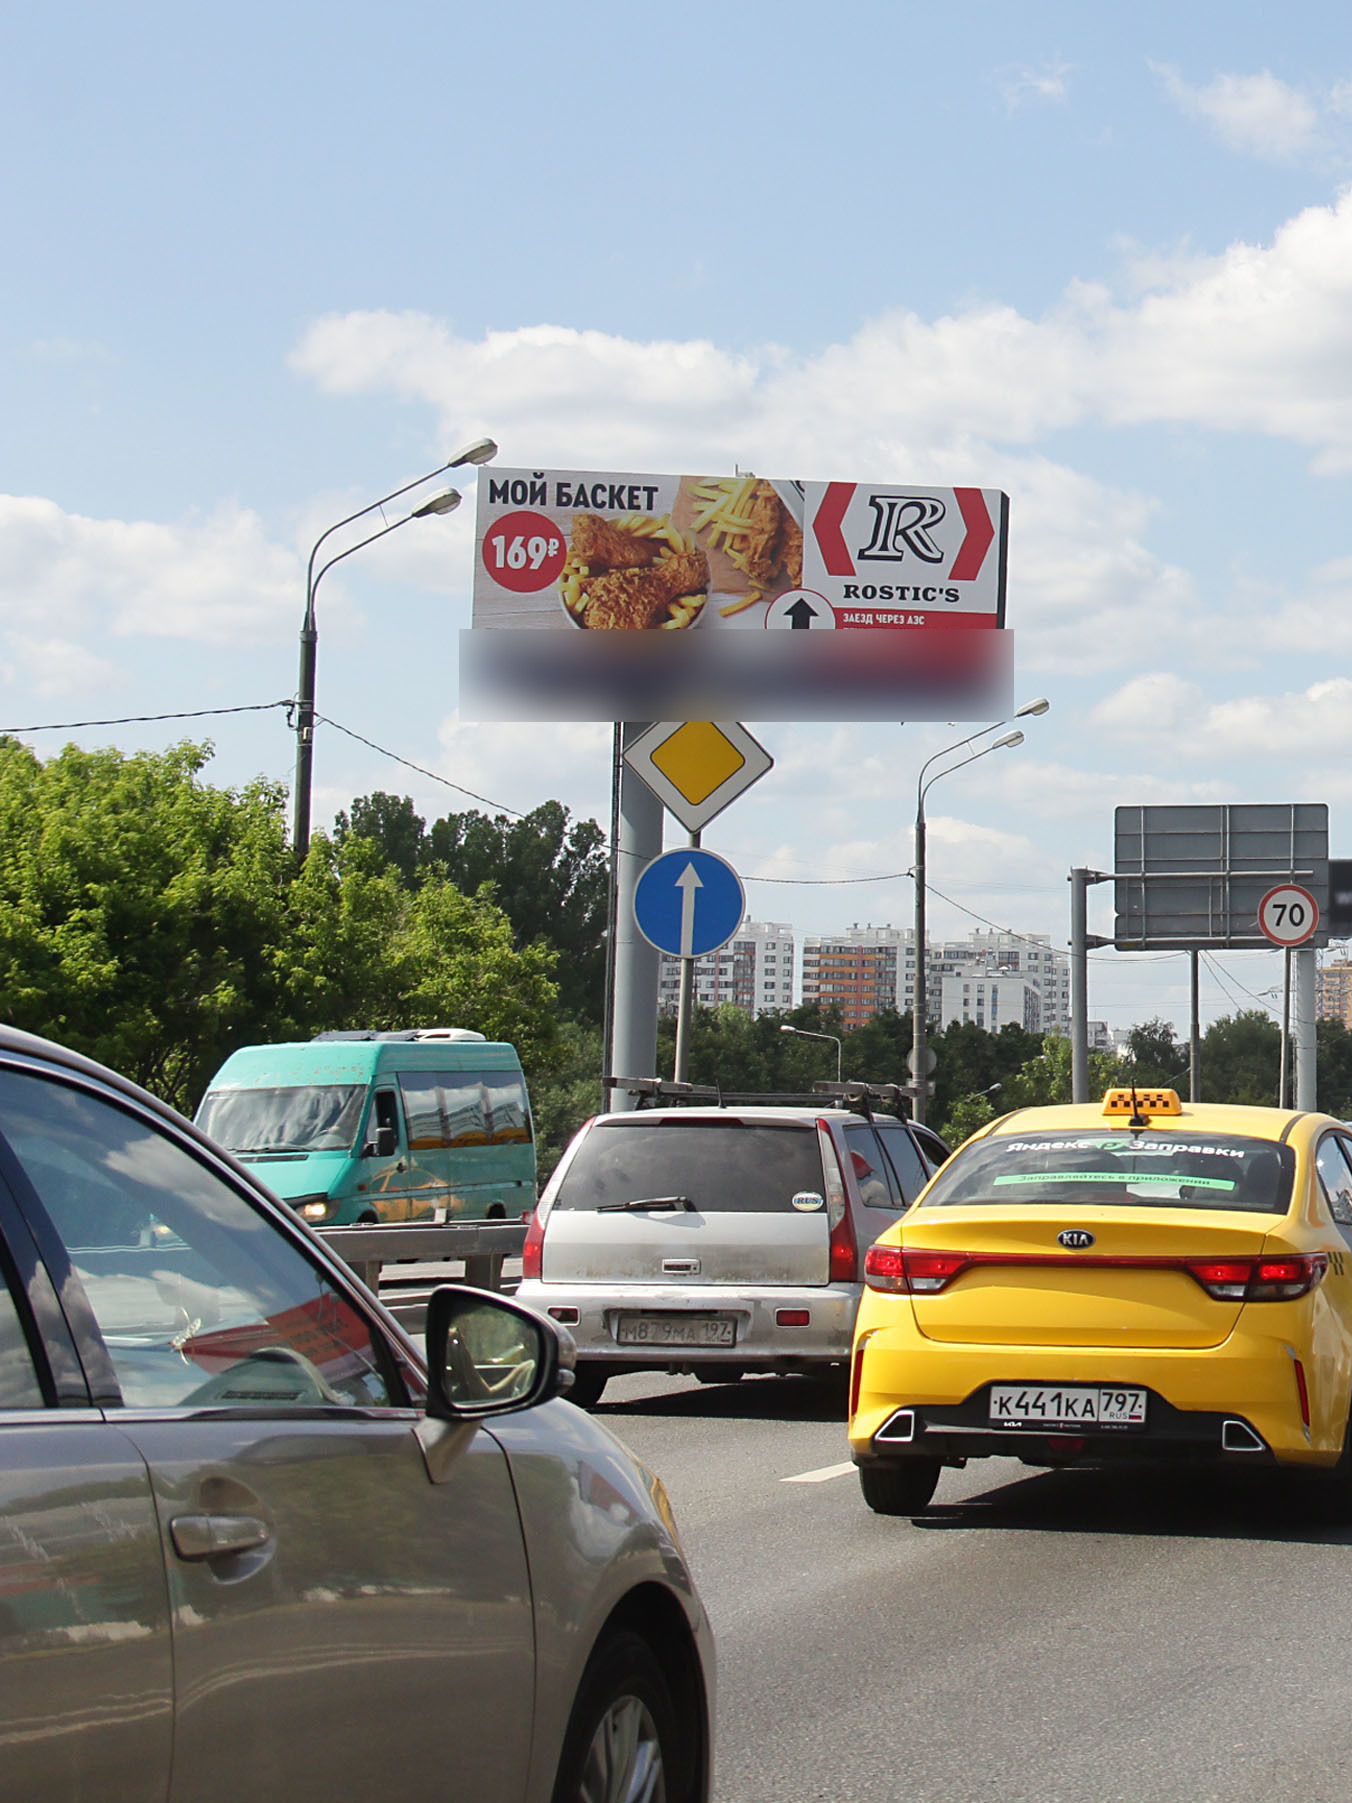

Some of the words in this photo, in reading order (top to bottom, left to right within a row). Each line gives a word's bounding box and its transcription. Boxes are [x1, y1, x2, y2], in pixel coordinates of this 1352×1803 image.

[489, 472, 547, 506] МОЙ
[556, 482, 659, 511] БАСКЕТ
[857, 495, 946, 564] R
[843, 584, 960, 602] ROSTIC'S
[843, 613, 873, 624] ЗАЕЗД
[876, 614, 904, 625] ЧЕРЕЗ
[907, 615, 925, 625] АЗС
[1272, 903, 1305, 927] 70
[1006, 1142, 1091, 1152] Яндекс
[1129, 1140, 1245, 1158] Заправки
[1063, 1233, 1089, 1245] KIA
[1102, 1392, 1140, 1412] 797
